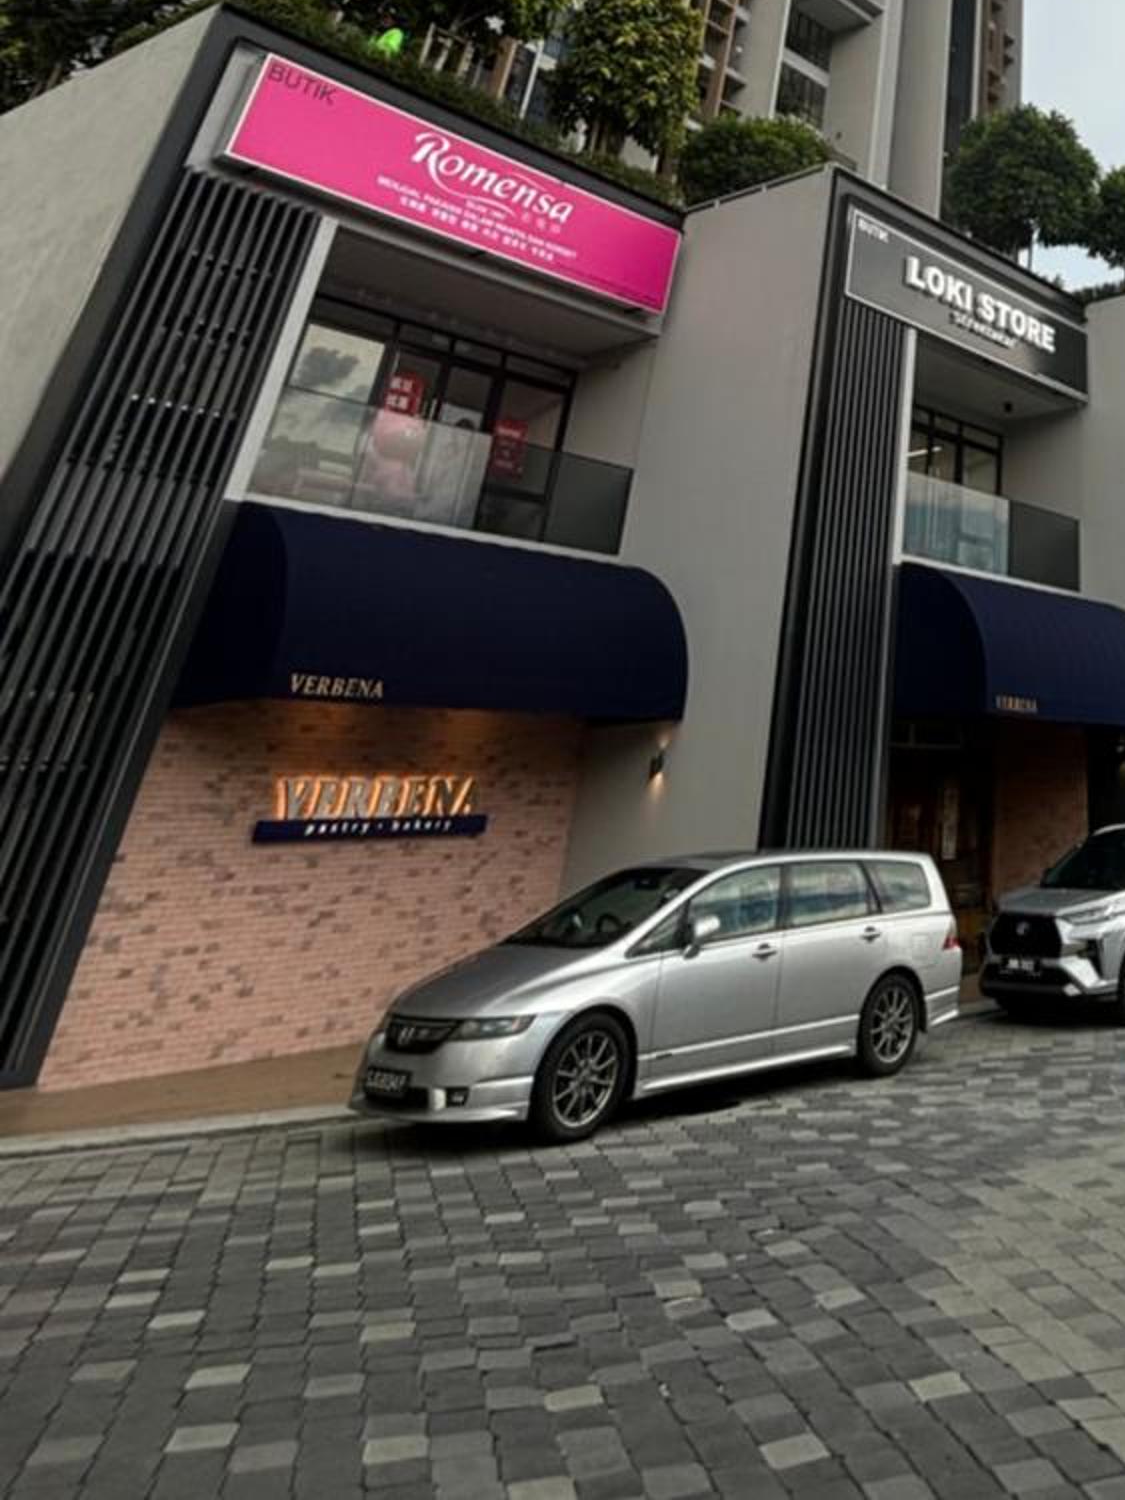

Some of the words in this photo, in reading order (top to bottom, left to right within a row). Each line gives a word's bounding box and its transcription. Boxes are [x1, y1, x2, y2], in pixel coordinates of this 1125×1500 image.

[267, 63, 334, 104] BUTIK
[412, 132, 574, 223] Romensa
[905, 256, 973, 311] LOKI
[976, 292, 1055, 353] STORE
[290, 673, 384, 699] VERBENA
[273, 774, 481, 820] VERBENA
